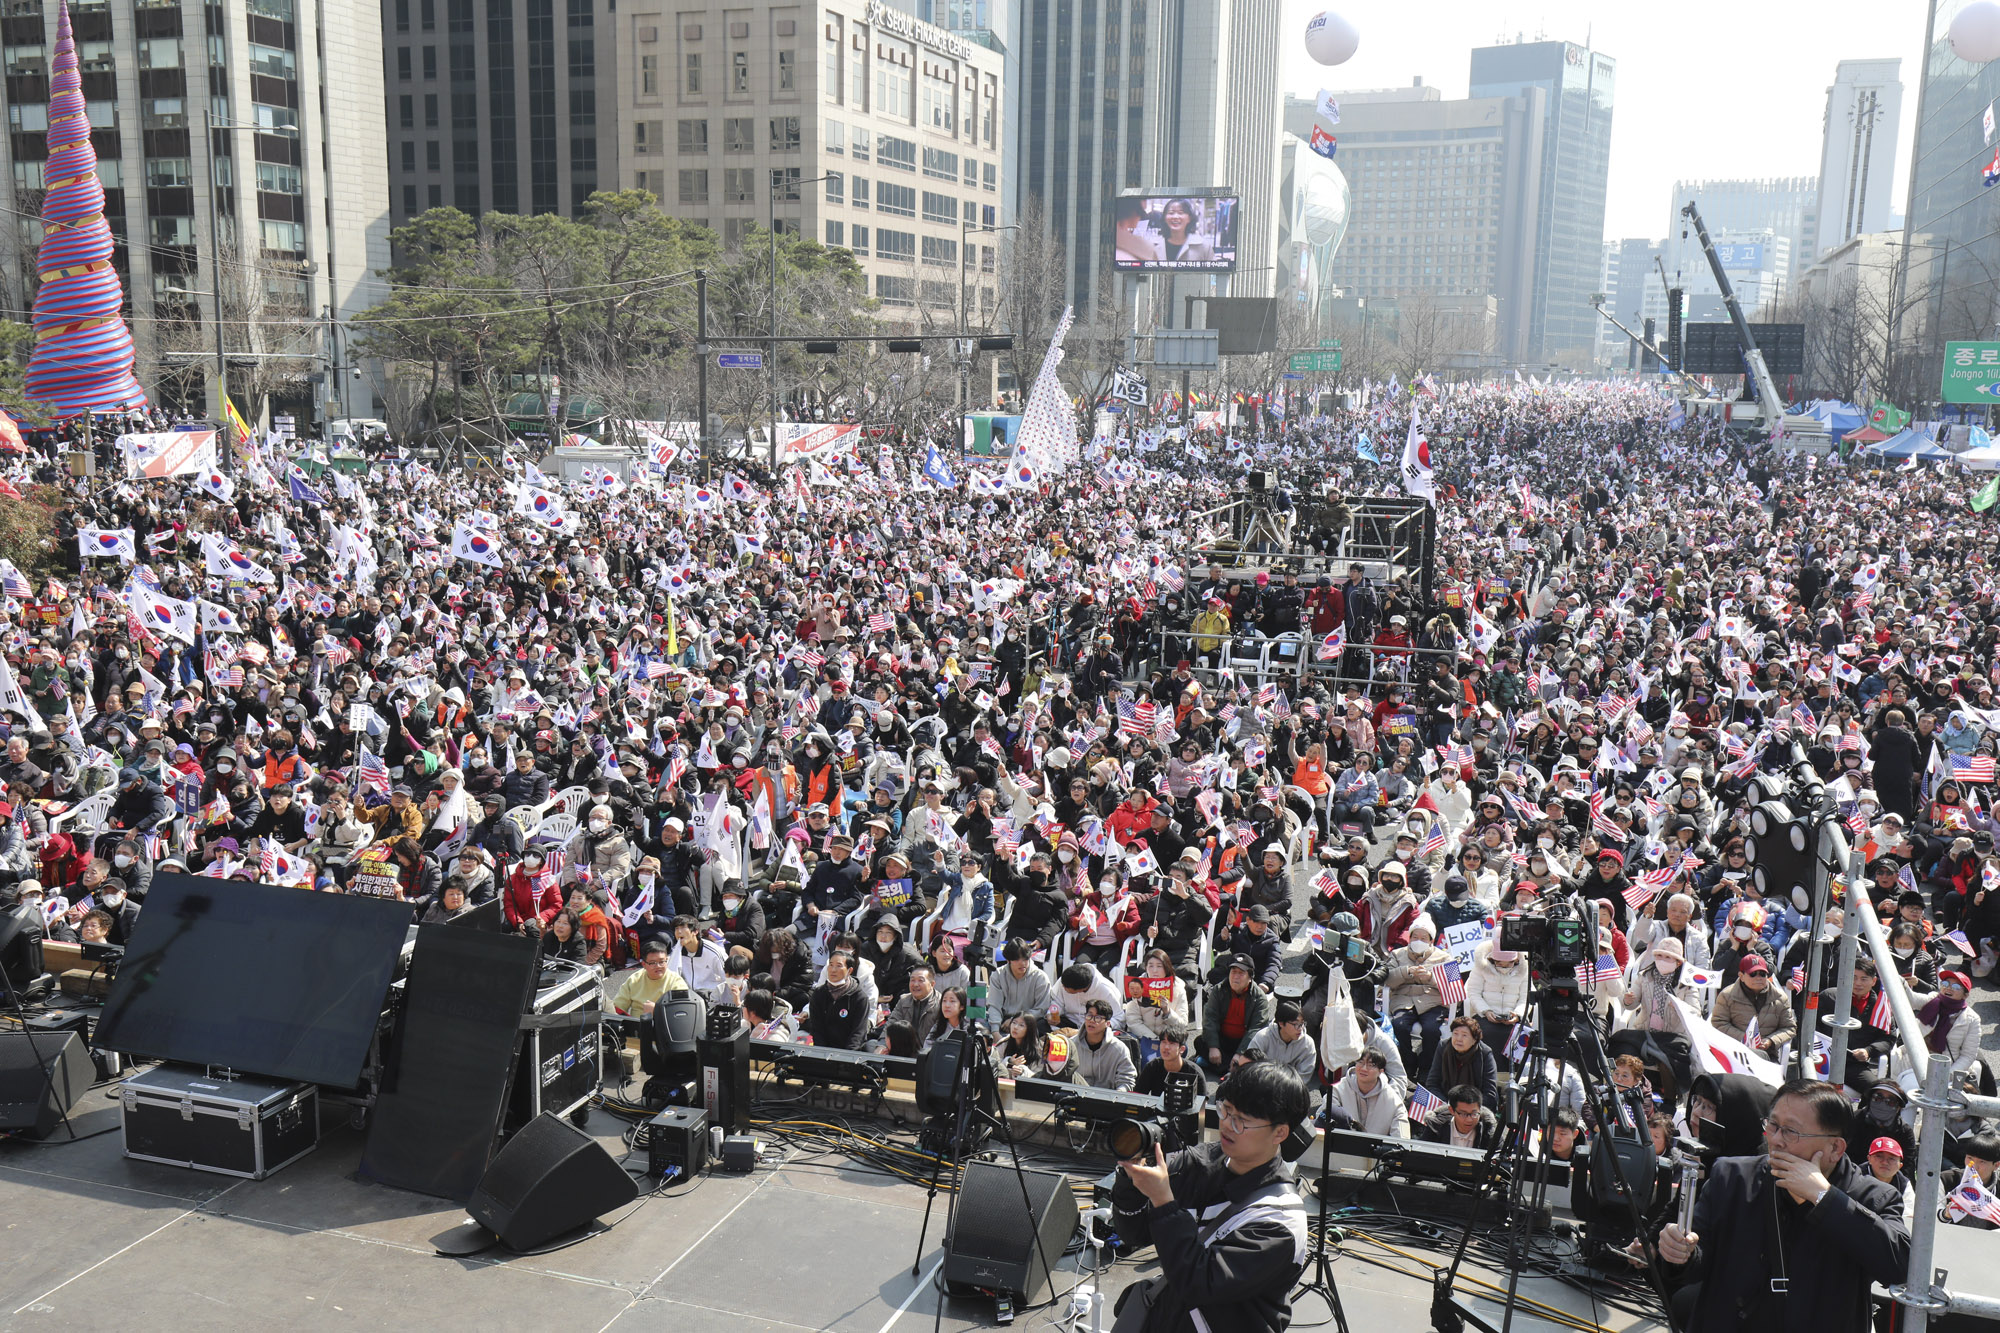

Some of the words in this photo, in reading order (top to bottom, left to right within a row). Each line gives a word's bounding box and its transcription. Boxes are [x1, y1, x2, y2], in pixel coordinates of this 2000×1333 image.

[886, 10, 914, 38] SEOUL
[915, 22, 947, 51] FINANCE
[947, 37, 974, 60] CENTER
[1720, 247, 1756, 263] 광고
[1953, 348, 2000, 366] 종로
[1950, 368, 1984, 381] Jongno
[1390, 716, 1408, 727] 국회
[878, 881, 904, 898] 국회
